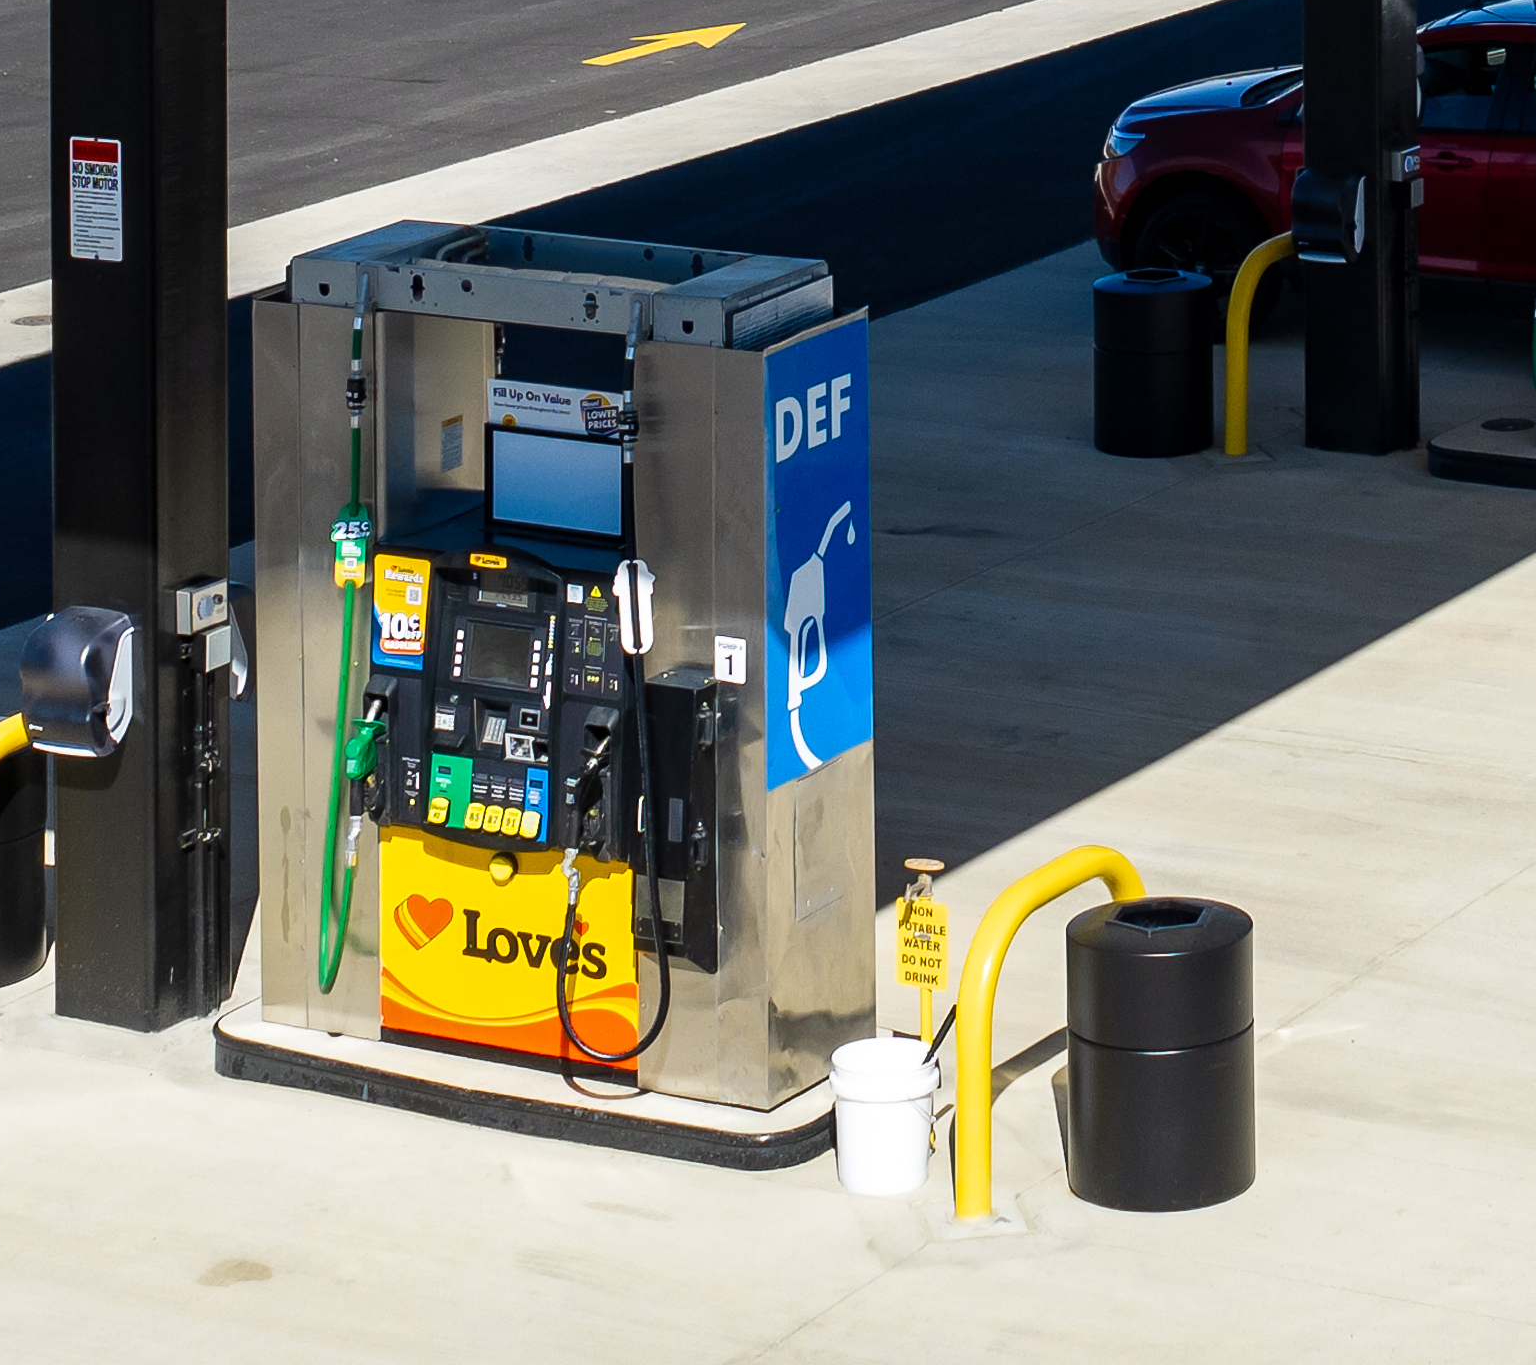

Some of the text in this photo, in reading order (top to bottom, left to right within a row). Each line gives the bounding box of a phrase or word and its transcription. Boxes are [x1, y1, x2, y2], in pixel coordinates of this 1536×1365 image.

[72, 162, 118, 177] NO SMOKING
[72, 175, 119, 191] STOP MOTOR
[493, 387, 507, 398] Fill
[509, 388, 524, 402] Up
[525, 391, 541, 402] On
[543, 393, 572, 406] Value
[587, 409, 617, 420] LOWER
[776, 373, 852, 463] DEF
[588, 418, 617, 429] PRICES
[334, 521, 369, 540] 25¢
[378, 612, 420, 640] 10¢
[725, 654, 732, 676] 1
[488, 815, 498, 824] 87
[910, 906, 933, 917] NON
[898, 920, 947, 937] POTABLE
[903, 937, 941, 952] WATER
[901, 954, 942, 969] DO NOT
[905, 971, 938, 985] DRINK
